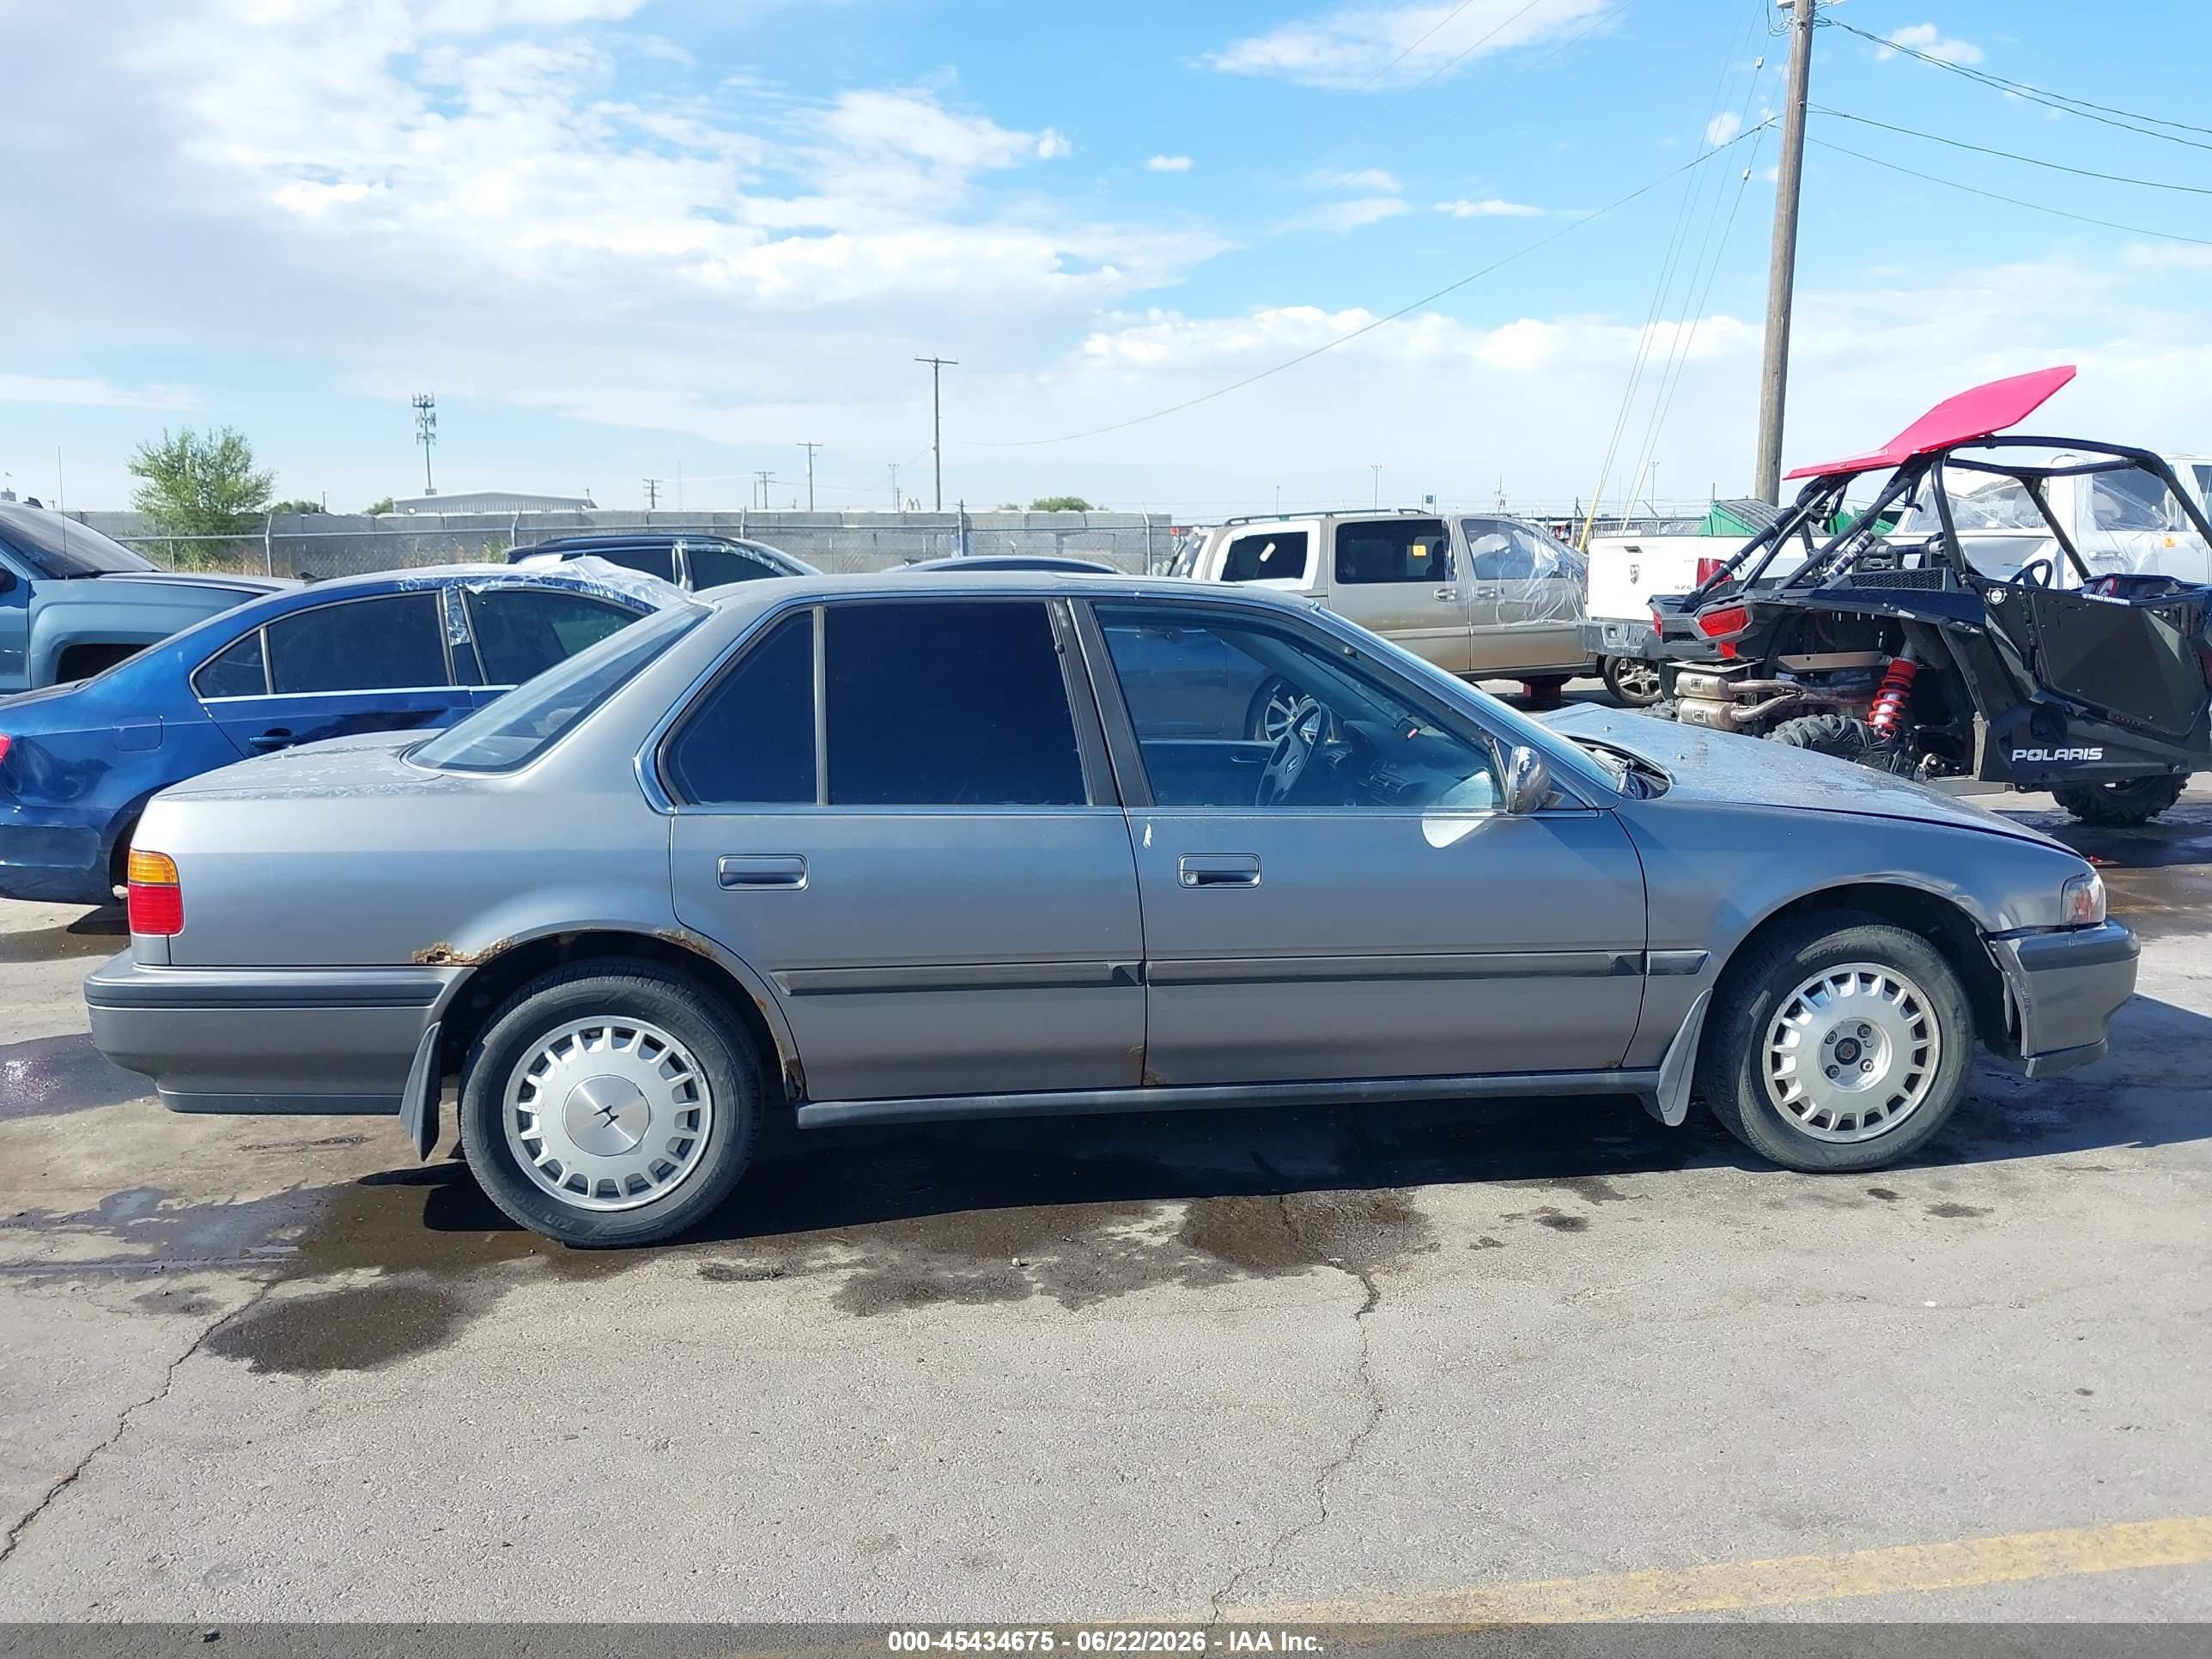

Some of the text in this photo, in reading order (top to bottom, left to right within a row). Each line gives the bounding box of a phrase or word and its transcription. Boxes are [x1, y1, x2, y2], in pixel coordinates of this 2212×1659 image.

[2087, 593, 2131, 606] PRO ARMOR
[2011, 747, 2103, 762] POLARIS
